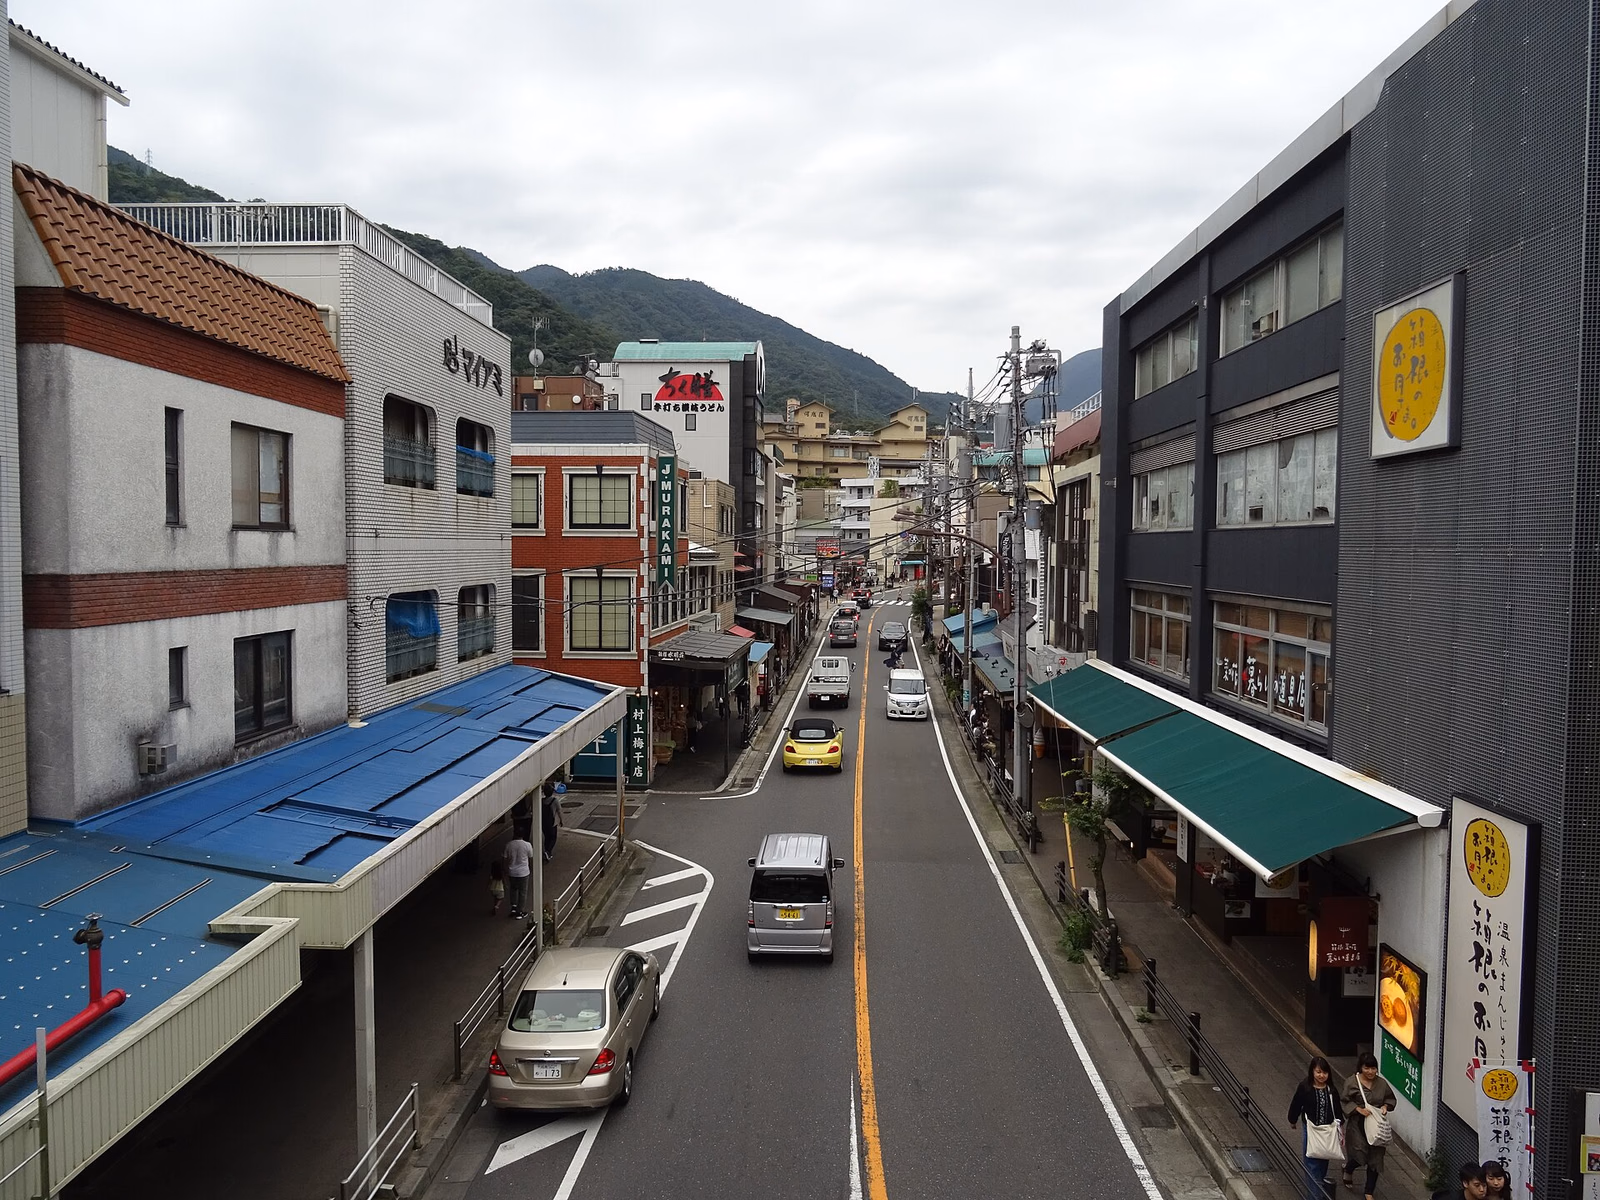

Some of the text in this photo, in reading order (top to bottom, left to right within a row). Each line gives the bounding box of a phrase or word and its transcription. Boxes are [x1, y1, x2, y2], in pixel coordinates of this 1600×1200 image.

[632, 708, 645, 778] 村上梅干店
[1496, 921, 1511, 1067] 温泉まんじゅう
[1404, 1078, 1417, 1099] 2F
